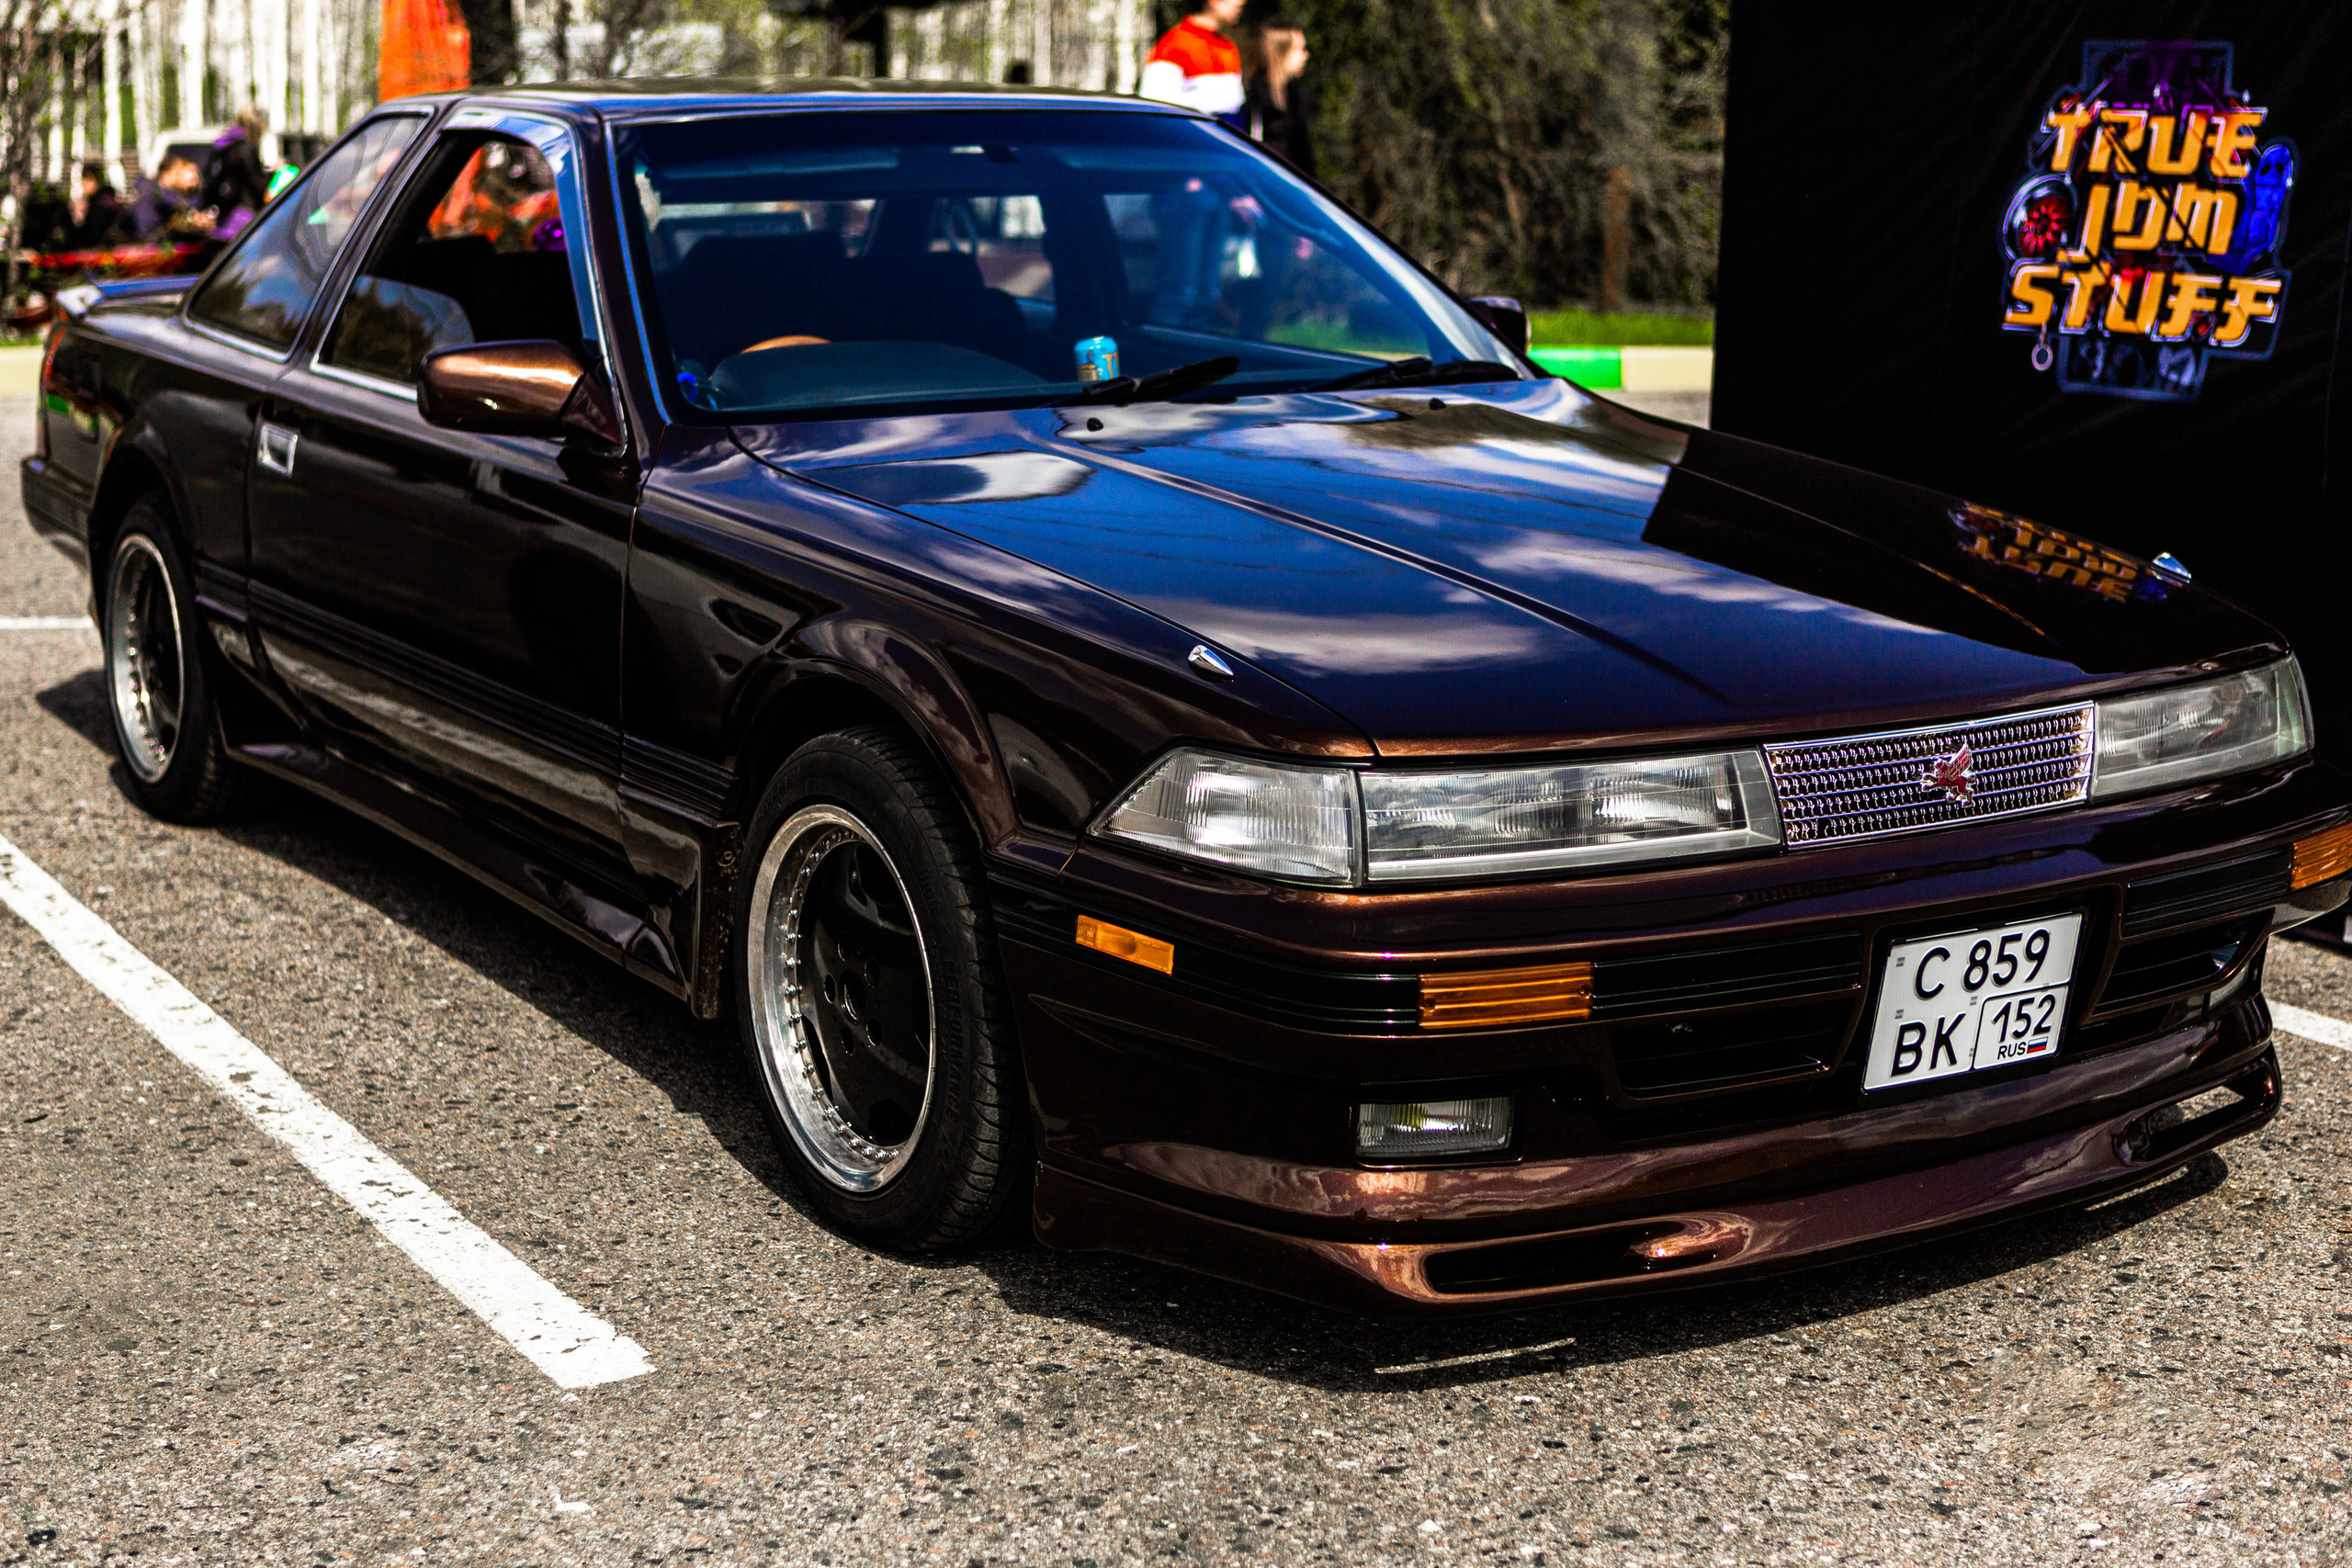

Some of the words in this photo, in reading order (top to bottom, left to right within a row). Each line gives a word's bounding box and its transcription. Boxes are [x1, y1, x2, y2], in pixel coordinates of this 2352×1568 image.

[2043, 104, 2267, 178] TRUE
[2056, 180, 2238, 264] JDM
[2004, 264, 2282, 345] STUFF
[1915, 946, 1951, 1000] C
[1962, 929, 2051, 992] 859
[942, 959, 965, 1122] PERFORMANCE
[1891, 1013, 1967, 1077] BK
[1991, 994, 2056, 1043] 152
[1997, 1042, 2027, 1060] RUS
